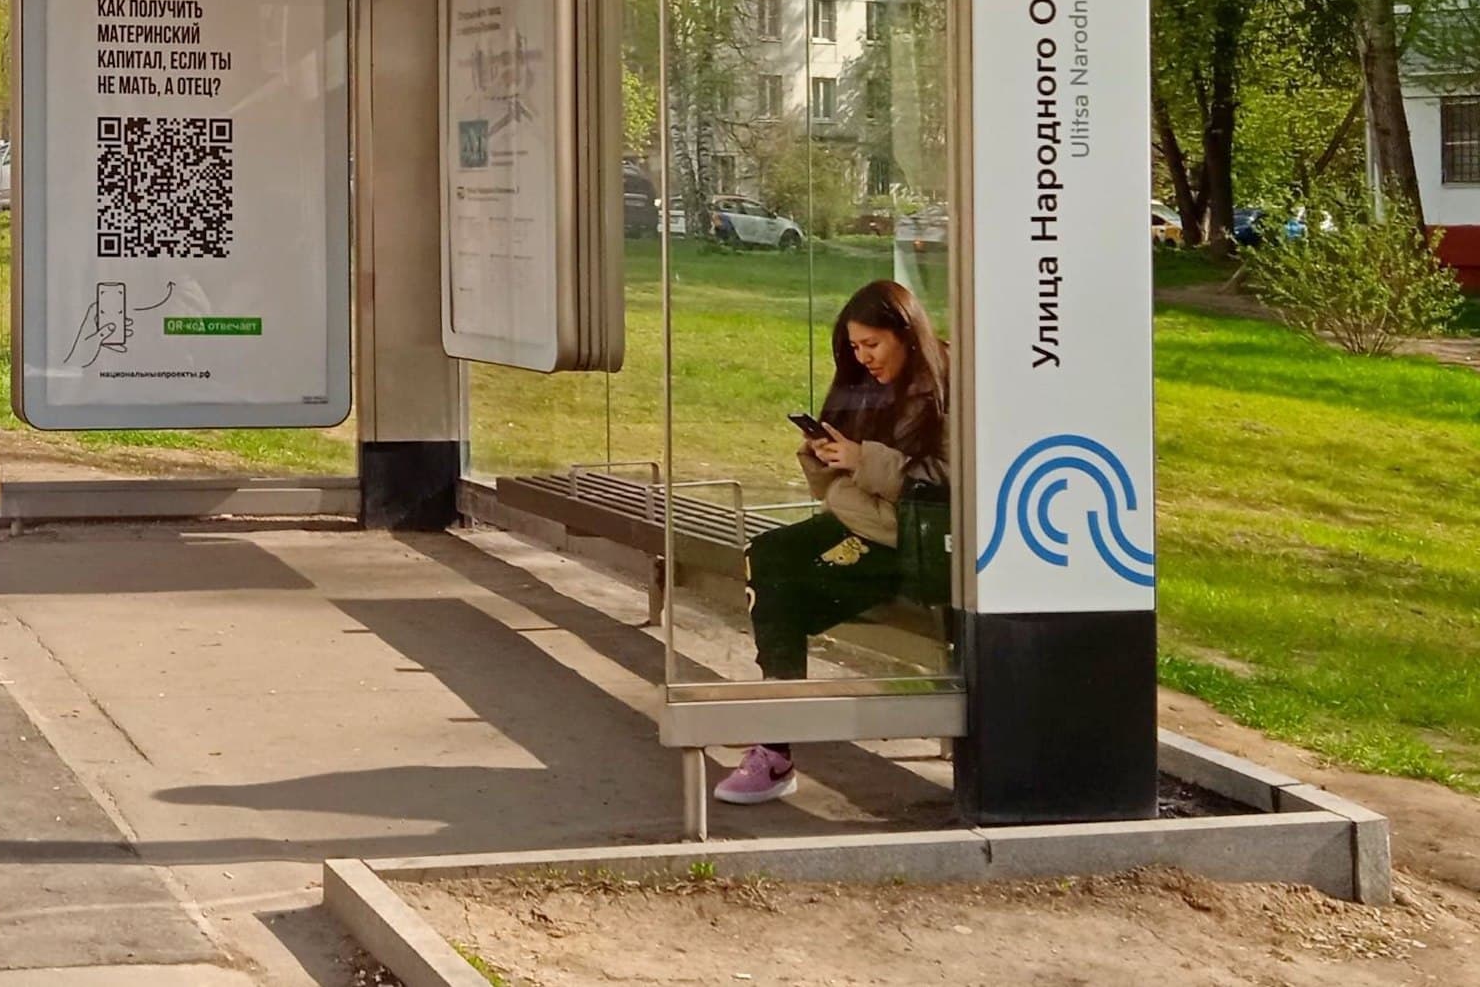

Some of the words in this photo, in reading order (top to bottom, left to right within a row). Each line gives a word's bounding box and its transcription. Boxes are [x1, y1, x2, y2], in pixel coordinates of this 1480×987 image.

[129, 0, 203, 19] ПОЛУЧИТЬ
[97, 22, 201, 44] МАТЕРИНСКИЙ
[97, 49, 167, 71] КАПИТАЛ,
[170, 51, 207, 70] ЕСЛИ
[210, 52, 232, 70] ТЫ
[97, 75, 116, 94] НЕ
[119, 76, 161, 97] МАТЬ,
[164, 77, 174, 95] А
[177, 77, 222, 98] ОТЕЦ?
[1070, 94, 1090, 158] Ulitsa
[1030, 37, 1064, 241] Народного
[1031, 256, 1063, 368] Улица
